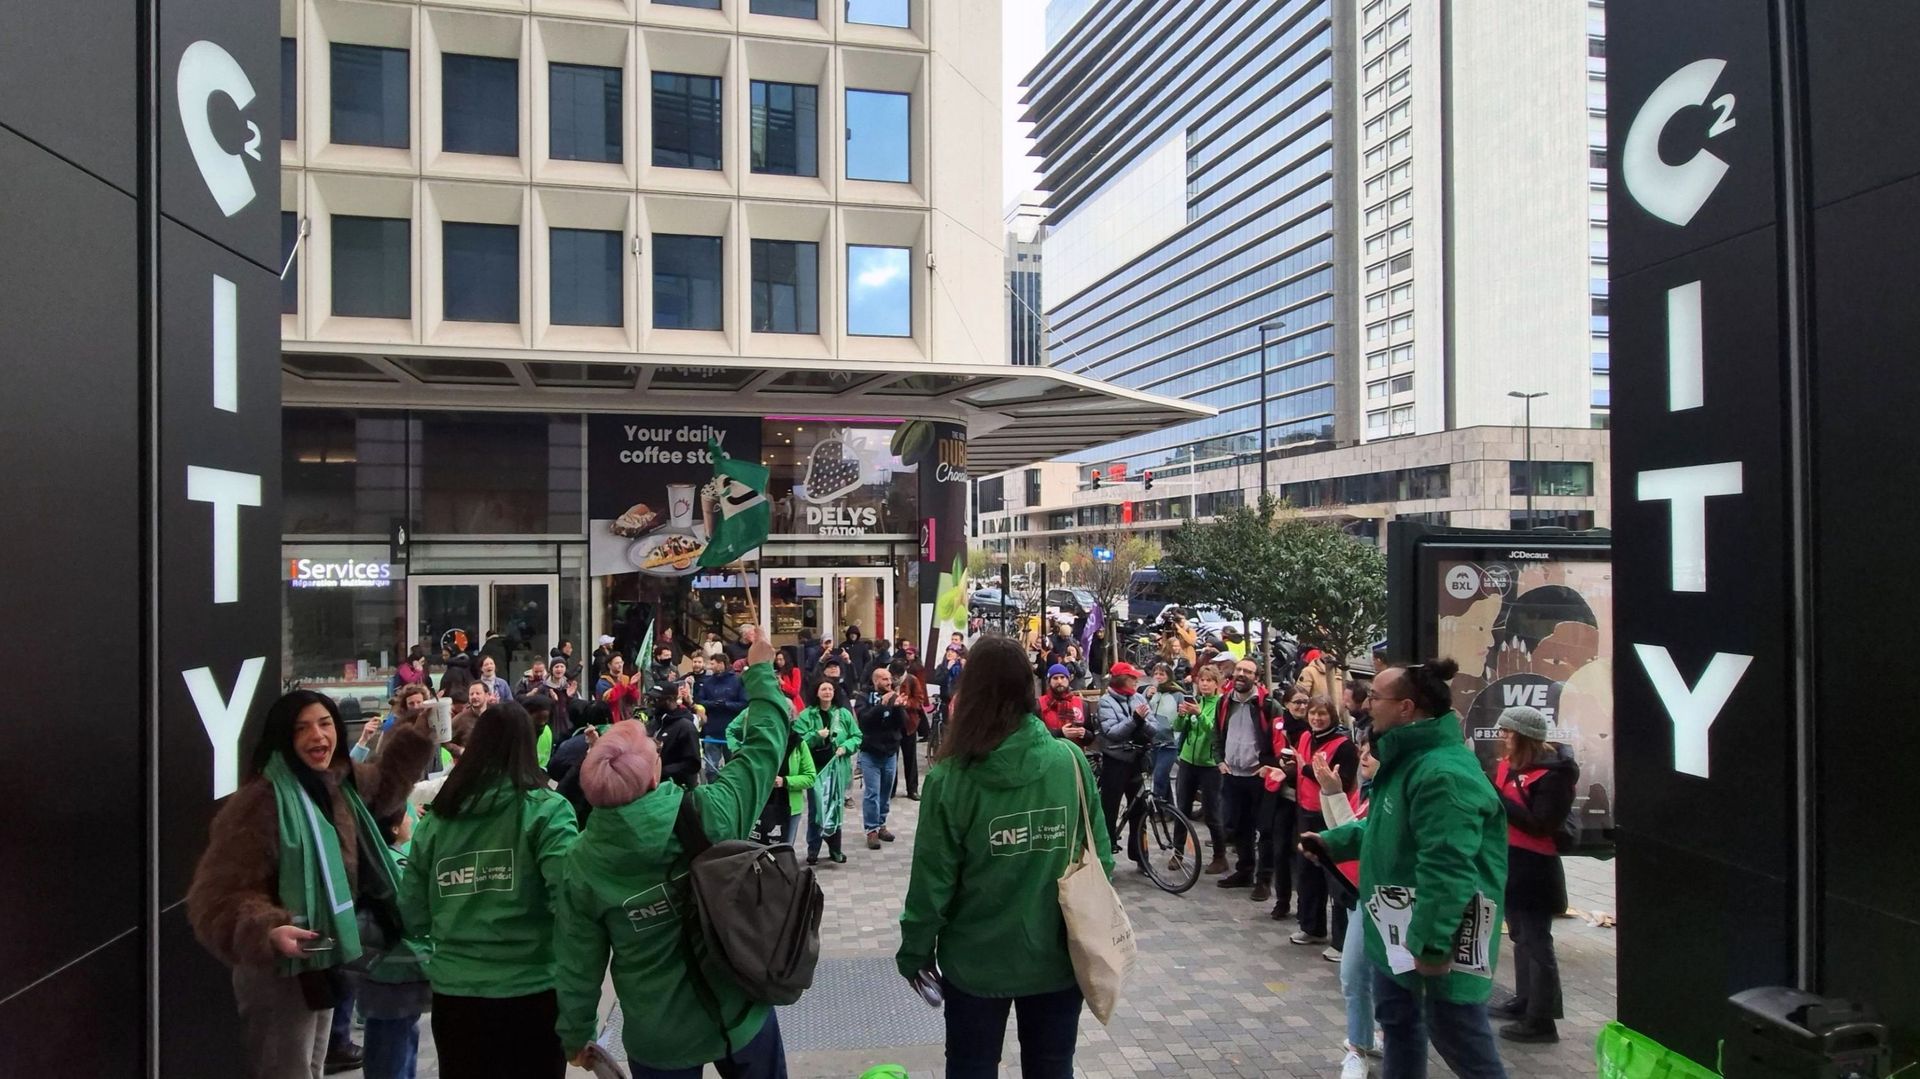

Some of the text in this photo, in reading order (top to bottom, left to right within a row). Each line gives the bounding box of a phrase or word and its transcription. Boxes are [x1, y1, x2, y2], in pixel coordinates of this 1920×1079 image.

[623, 424, 727, 447] Your daily
[619, 446, 731, 464] coffee sto
[806, 506, 877, 526] DELYS
[818, 526, 865, 537] STATION
[1508, 550, 1549, 560] JCDecaux
[290, 559, 390, 579] iServices
[1452, 581, 1473, 591] BXL
[1502, 684, 1549, 707] WE
[989, 826, 1029, 846] CNE
[437, 866, 476, 887] CNE
[628, 899, 670, 921] CNE
